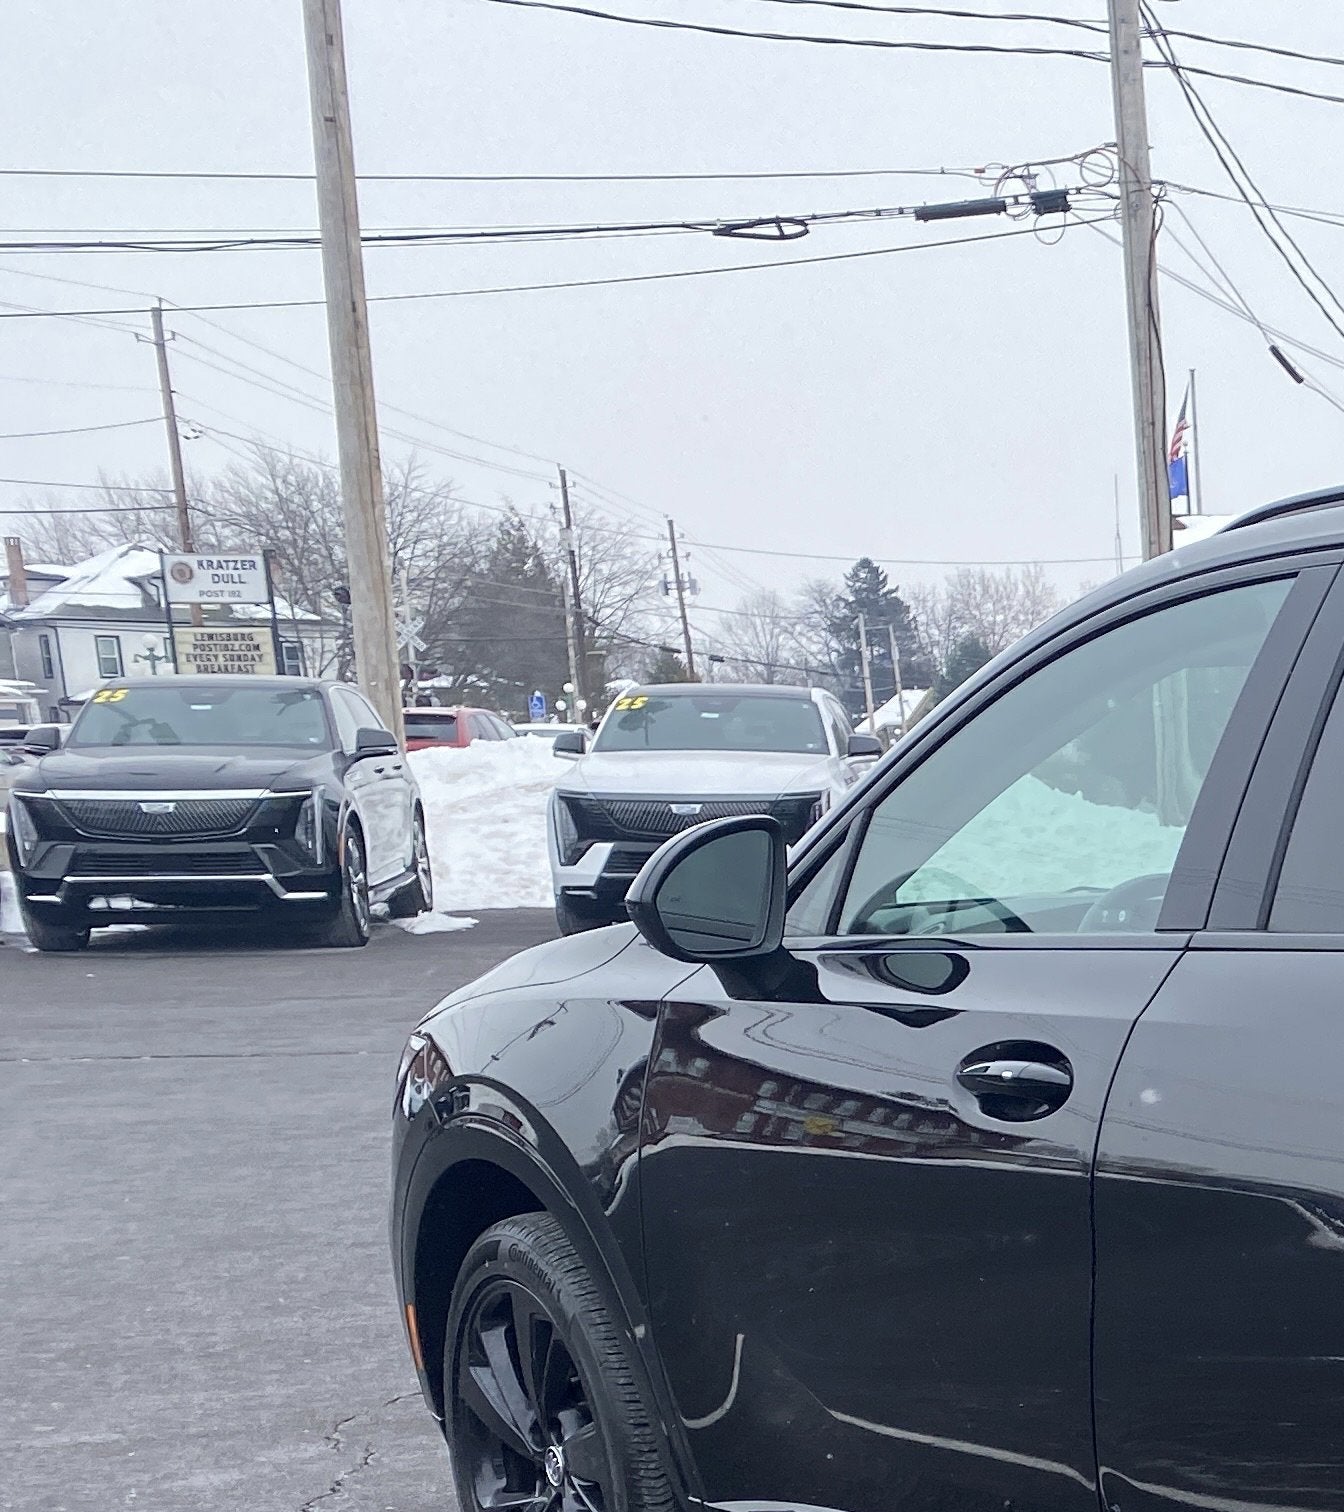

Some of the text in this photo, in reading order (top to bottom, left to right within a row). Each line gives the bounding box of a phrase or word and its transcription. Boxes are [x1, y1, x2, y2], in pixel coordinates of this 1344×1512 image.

[196, 559, 258, 571] KRATZER
[211, 573, 247, 585] DULL
[199, 589, 226, 598] POST
[193, 632, 254, 642] LEWISBURG
[222, 653, 264, 662] SUNDAY
[196, 663, 257, 674] BREAKFAST
[92, 688, 130, 703] 25
[615, 696, 649, 711] 25
